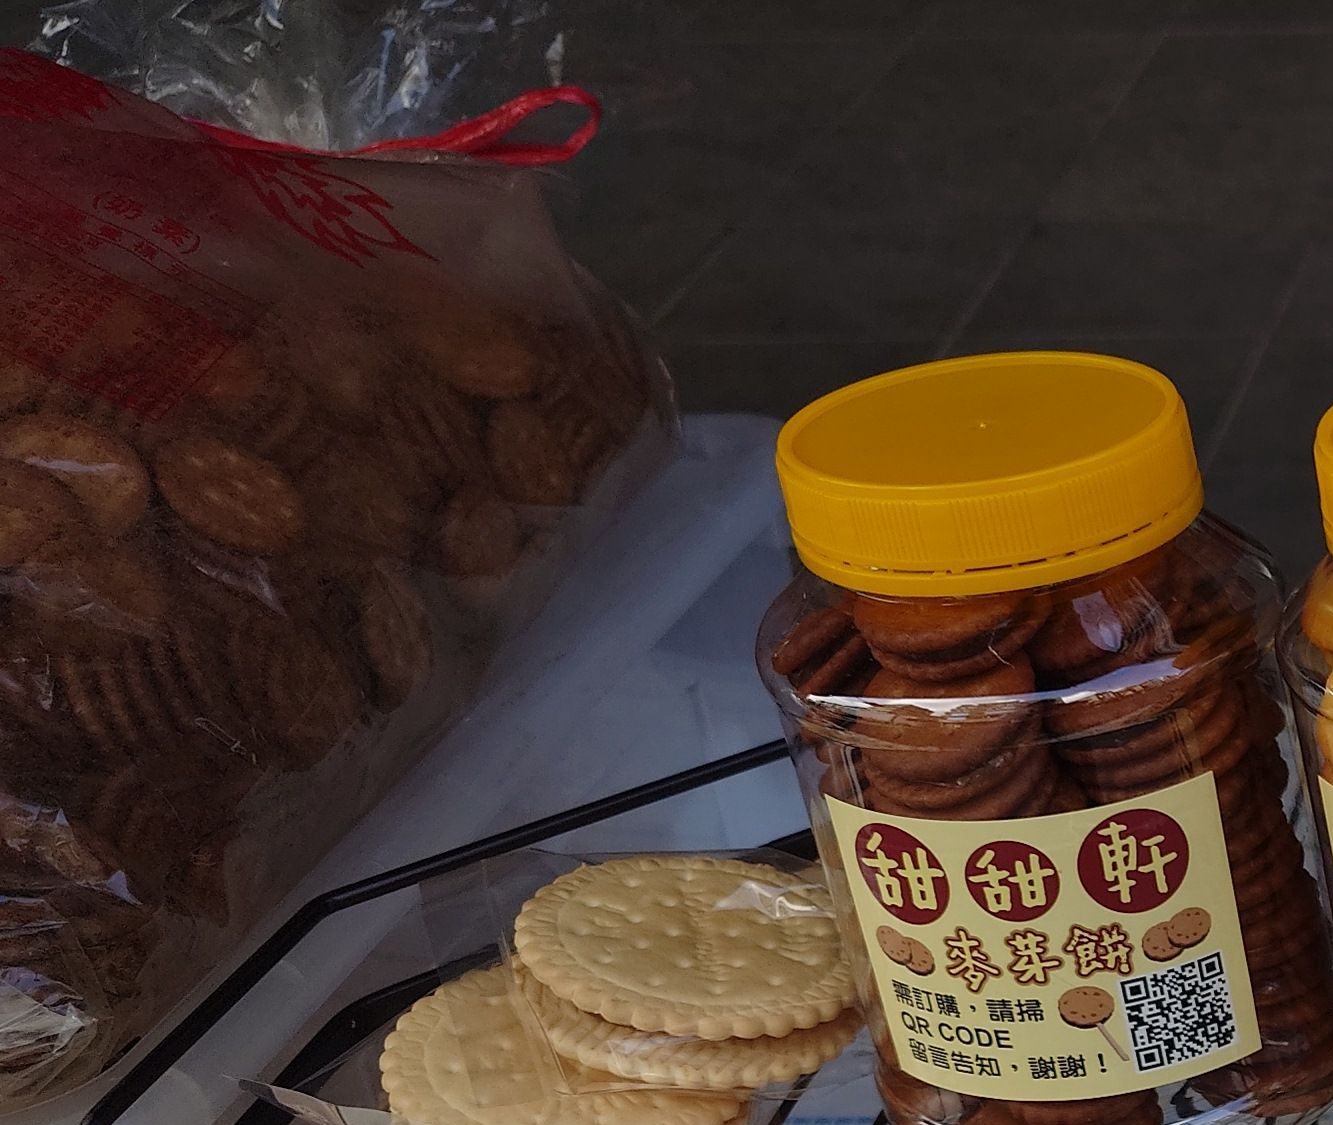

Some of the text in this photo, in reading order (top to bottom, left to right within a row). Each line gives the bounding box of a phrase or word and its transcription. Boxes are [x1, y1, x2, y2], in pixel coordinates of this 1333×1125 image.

[860, 822, 1179, 912] 甜甜軒
[944, 922, 1135, 993] 麥芽餅
[901, 1011, 1013, 1049] QR CODE
